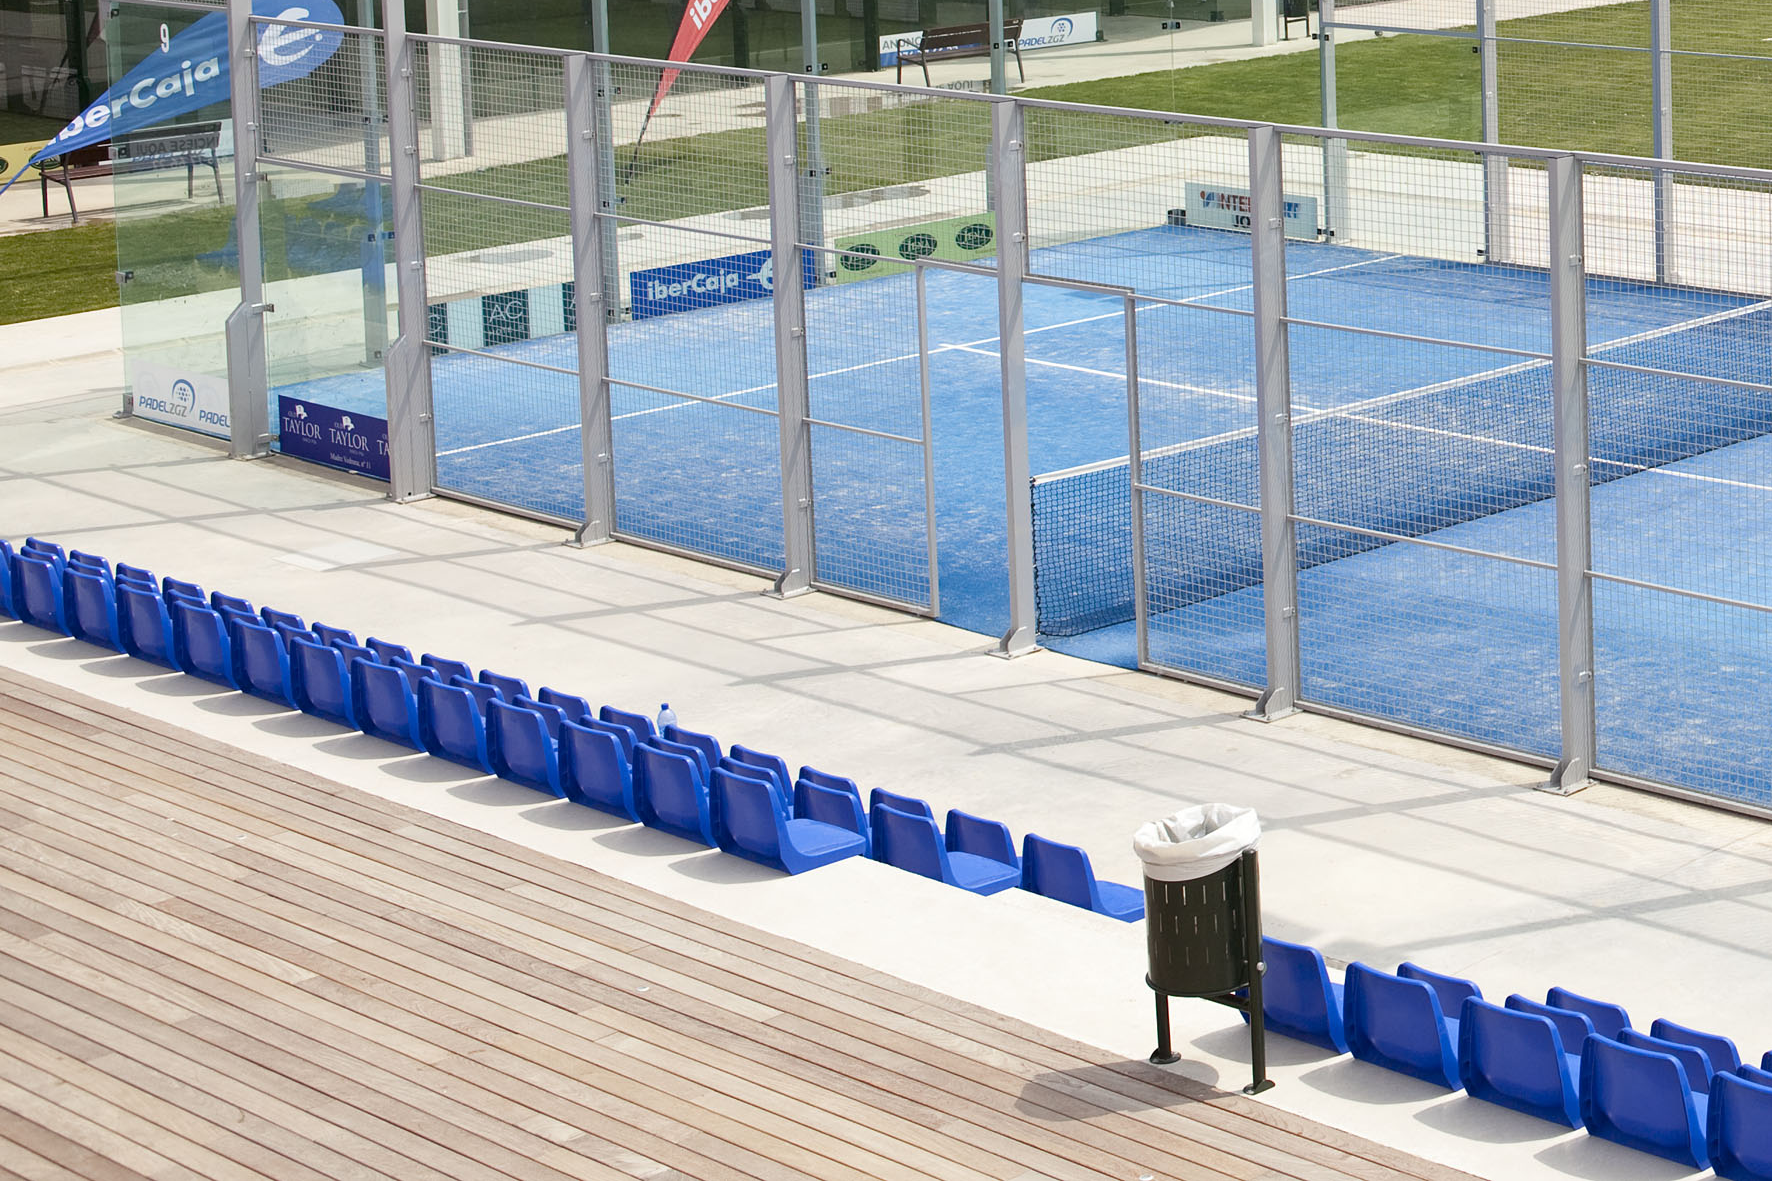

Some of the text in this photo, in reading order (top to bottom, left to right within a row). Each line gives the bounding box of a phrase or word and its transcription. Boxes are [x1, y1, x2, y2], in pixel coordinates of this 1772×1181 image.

[159, 22, 170, 54] 9
[48, 56, 220, 146] berCaja
[647, 270, 740, 302] iberCaja
[489, 300, 523, 323] AC
[139, 395, 231, 428] PADELZGZ PADEL
[282, 417, 322, 440] TAYLOR
[329, 428, 370, 452] TAYLOR
